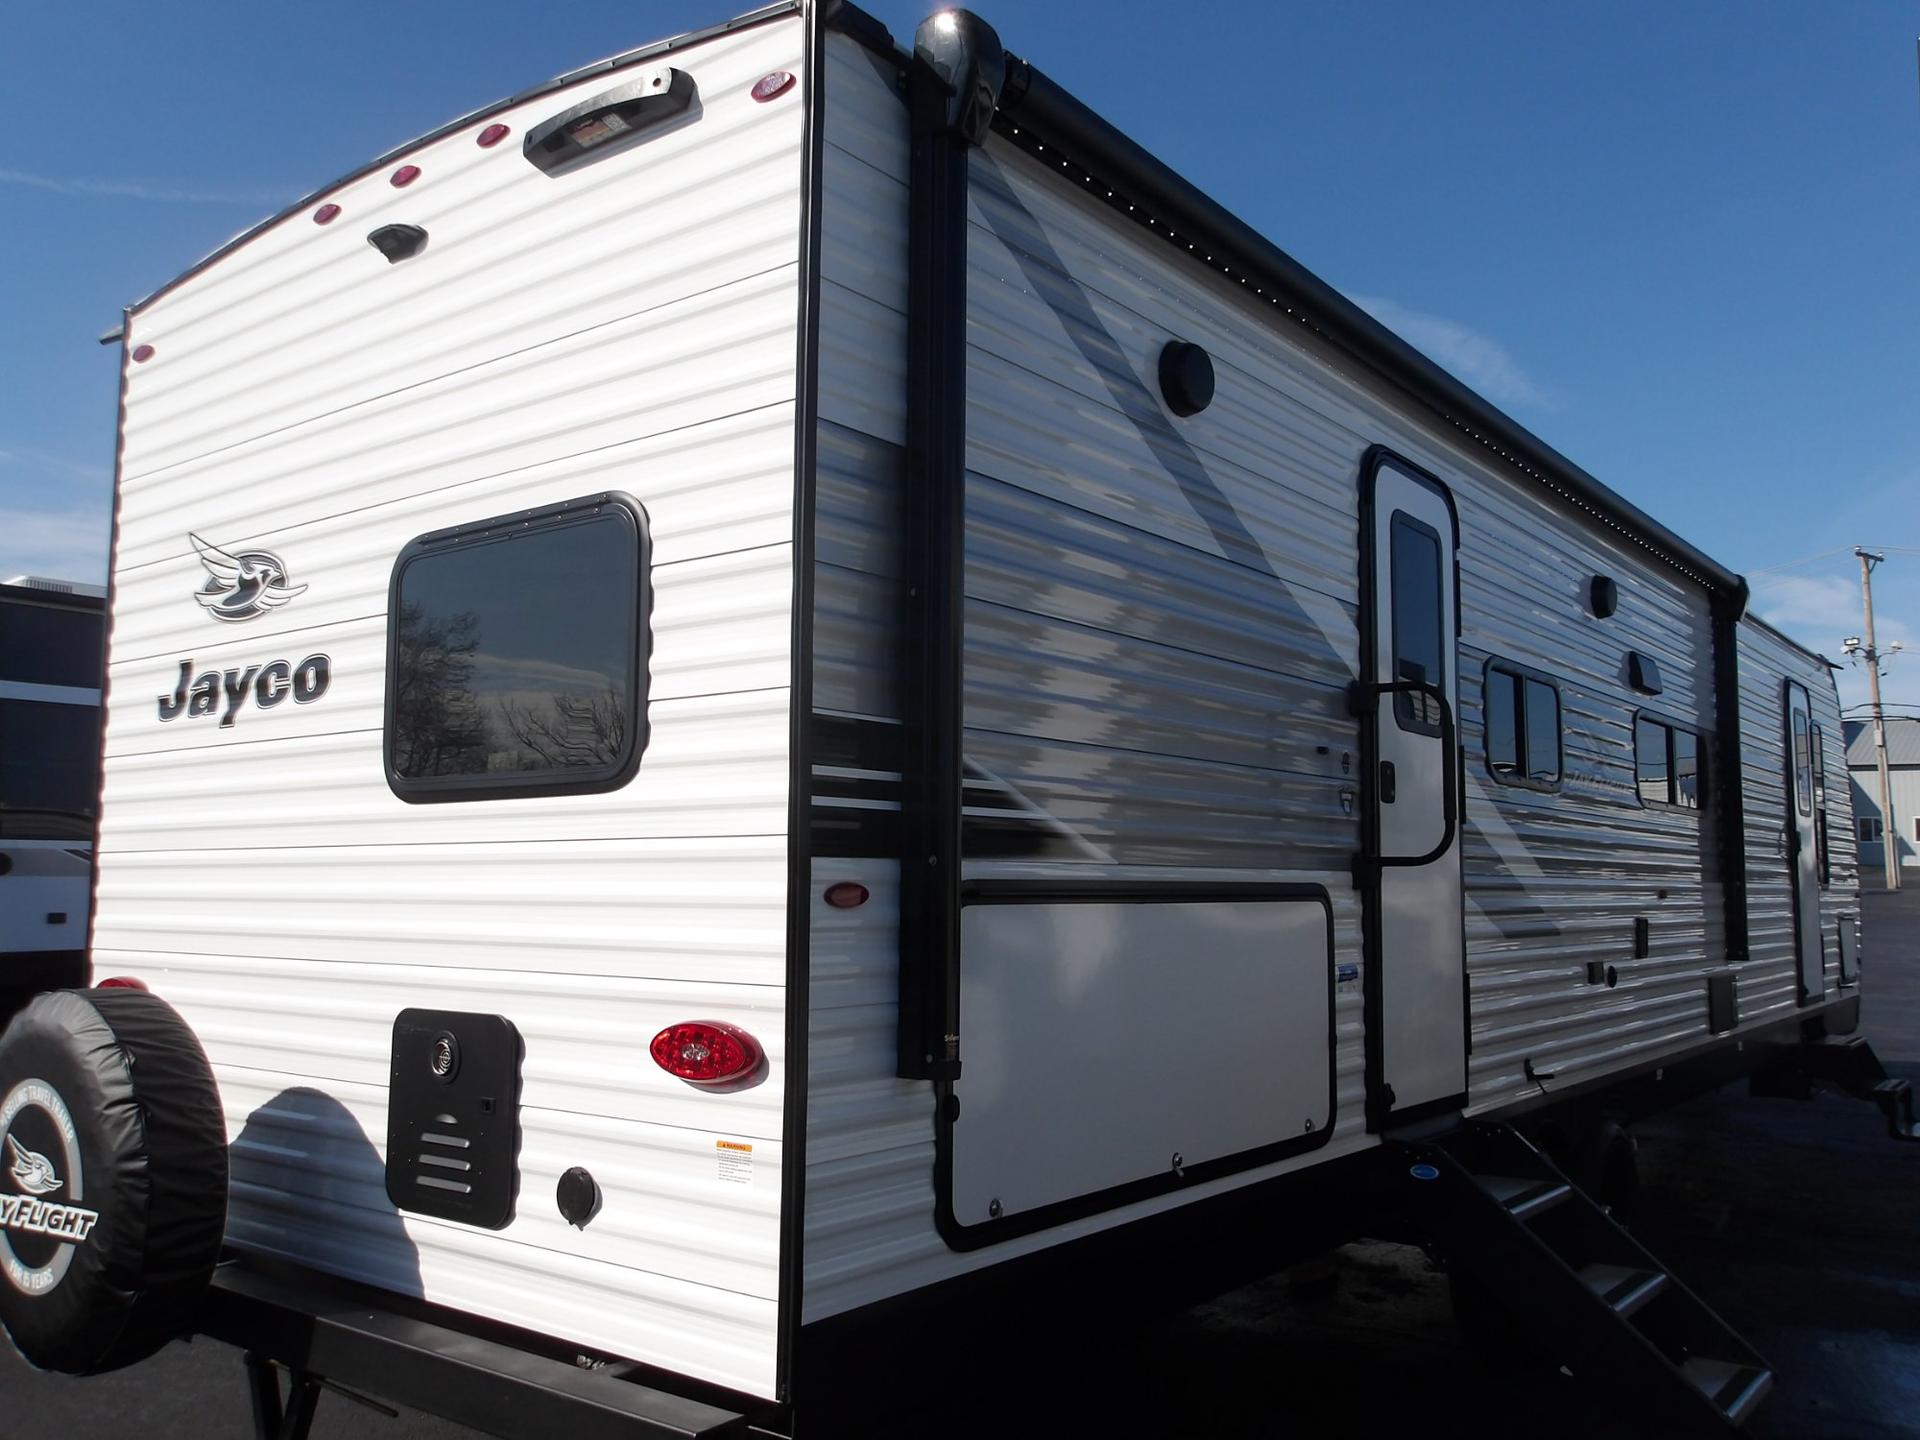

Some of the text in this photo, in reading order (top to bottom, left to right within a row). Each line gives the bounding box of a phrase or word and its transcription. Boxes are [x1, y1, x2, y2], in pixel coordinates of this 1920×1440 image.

[158, 653, 332, 729] Jayco
[28, 1086, 51, 1108] TRAVEL
[51, 1096, 74, 1142] TRAILER
